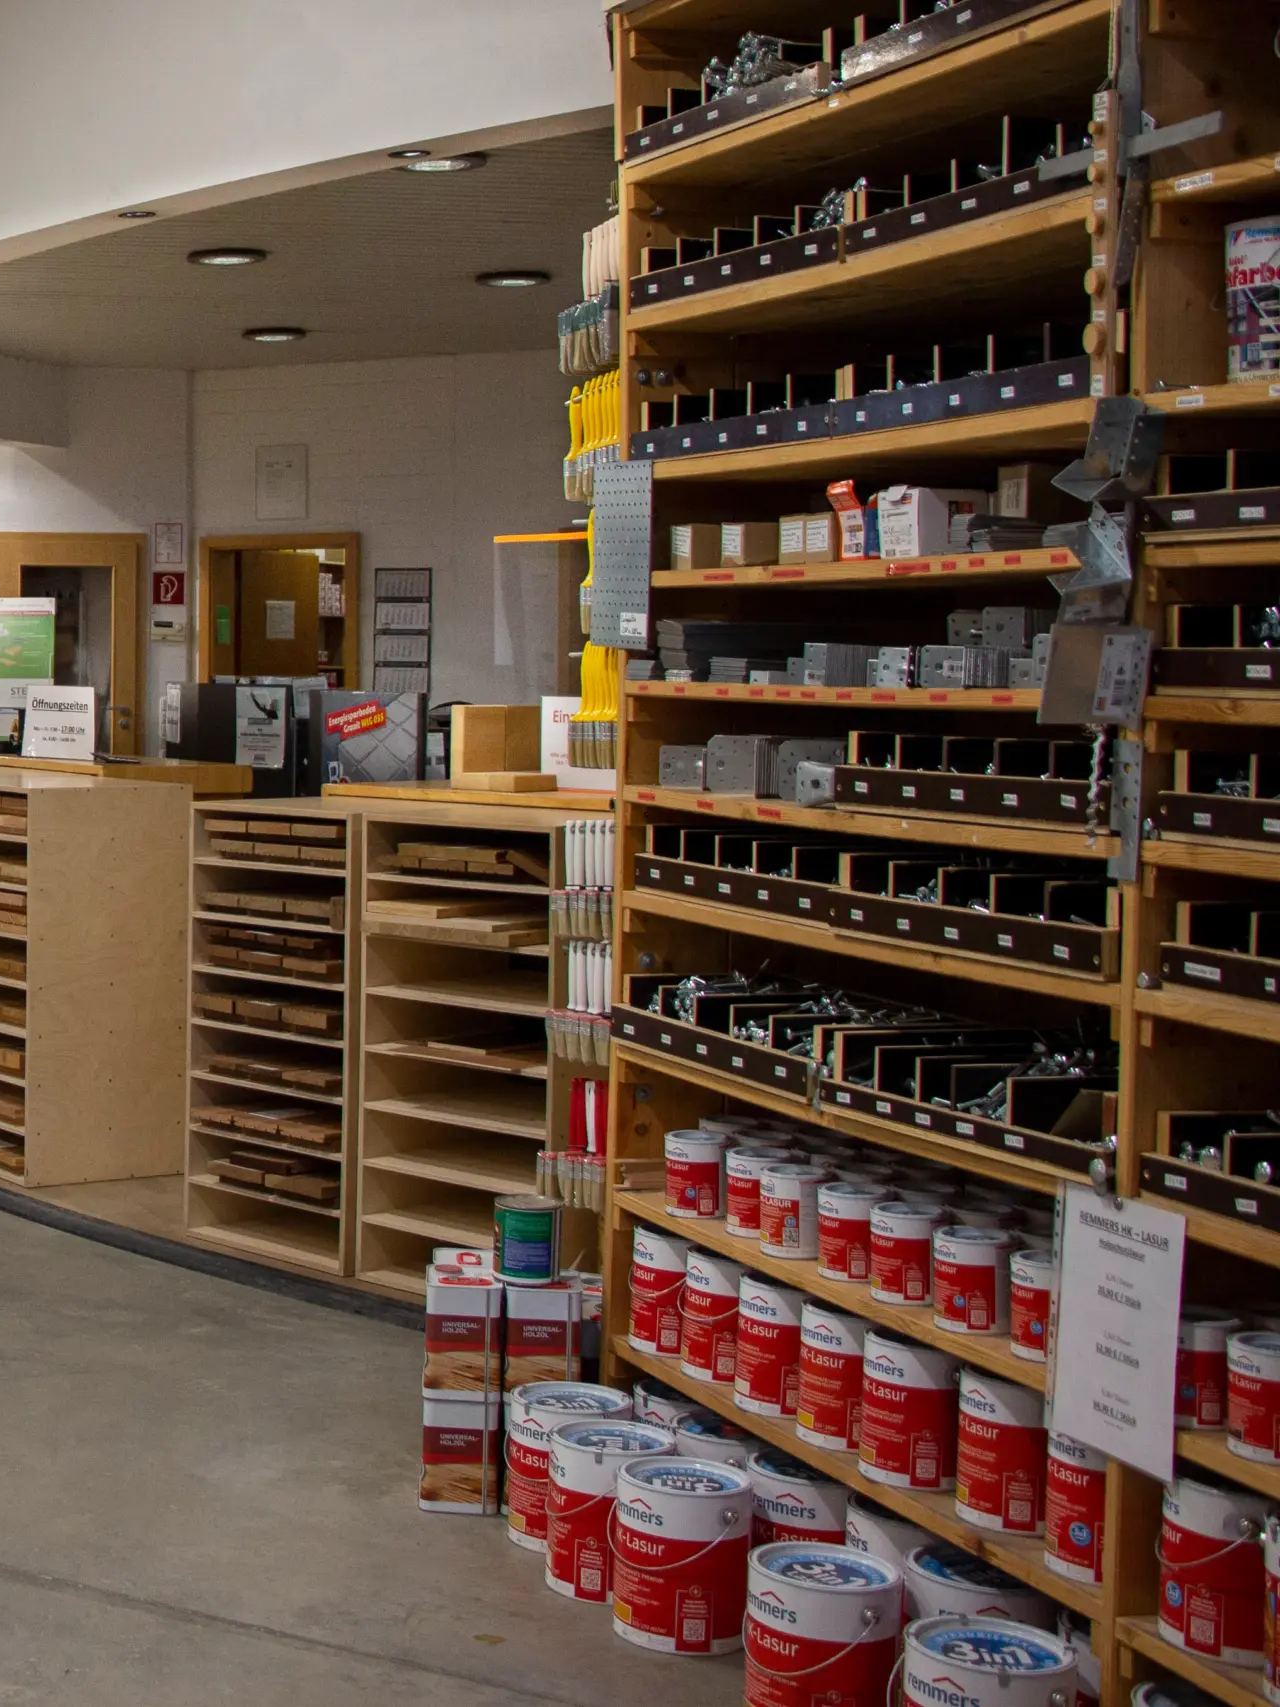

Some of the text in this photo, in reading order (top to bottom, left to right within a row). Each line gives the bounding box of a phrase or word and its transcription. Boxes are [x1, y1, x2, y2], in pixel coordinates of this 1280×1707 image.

[10, 686, 26, 696] STE
[31, 697, 89, 713] Öffnungszeiten
[1079, 1210, 1120, 1234] REMMERS
[1121, 1225, 1133, 1238] HK
[1141, 1230, 1169, 1250] LASUR
[633, 1265, 656, 1282] Lasur
[740, 1298, 777, 1317] emmers
[864, 1357, 905, 1378] emmers
[960, 1414, 1000, 1441] K-Lasur
[509, 1445, 549, 1470] K-Lasu
[617, 1500, 664, 1527] emmers
[747, 1590, 797, 1624] emmers
[747, 1619, 799, 1657] K-Lasur
[907, 1671, 980, 1707] remmers
